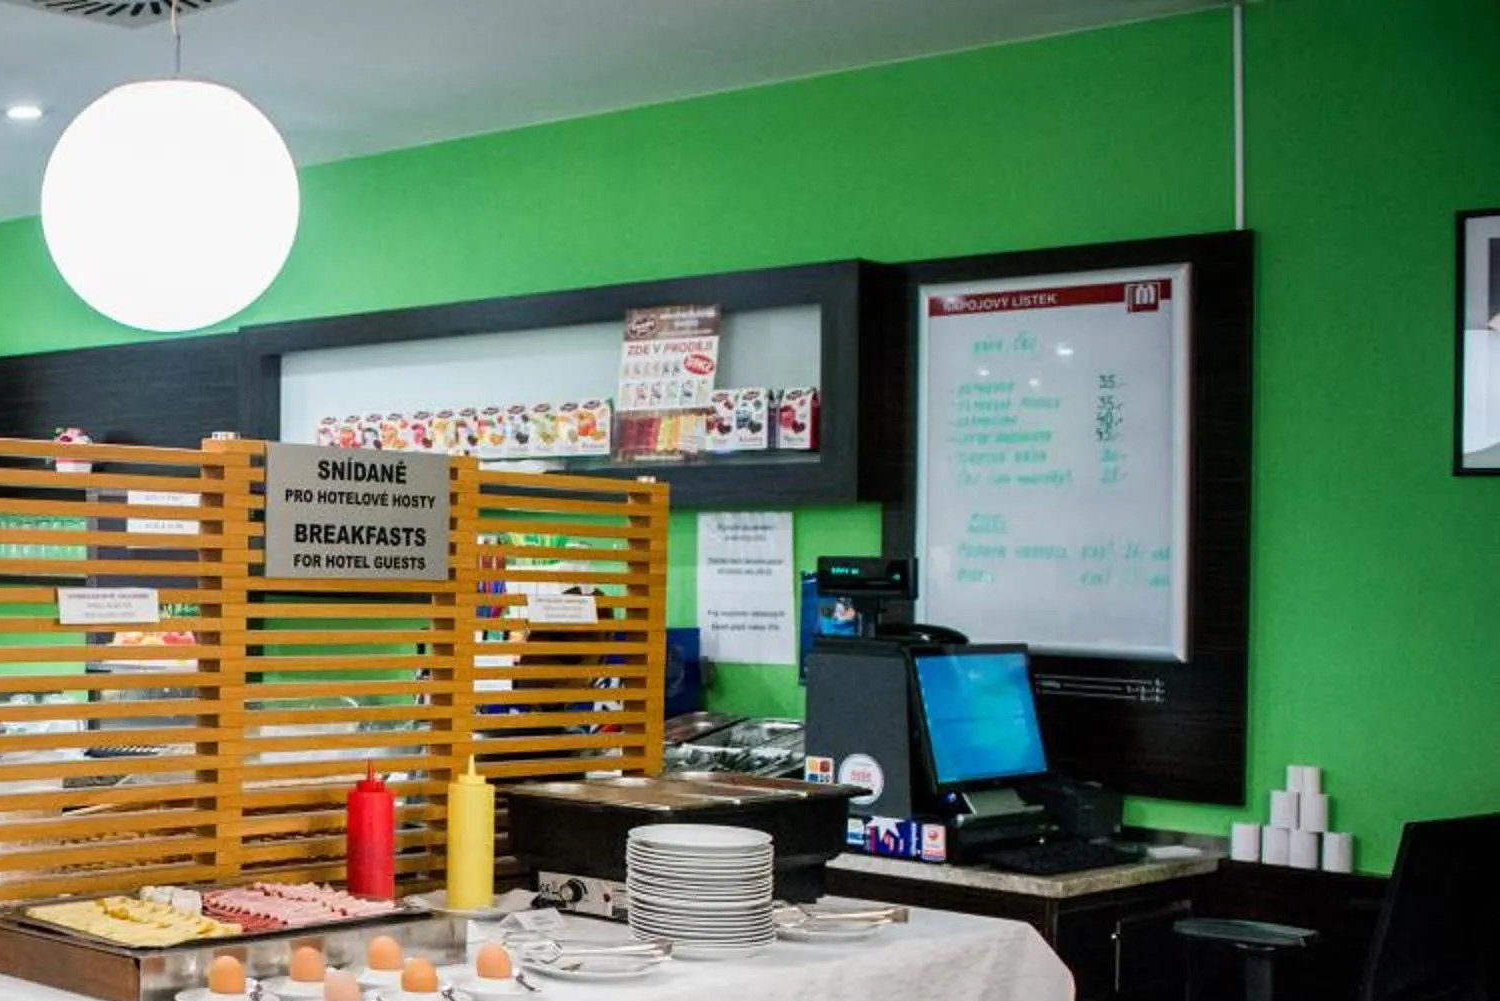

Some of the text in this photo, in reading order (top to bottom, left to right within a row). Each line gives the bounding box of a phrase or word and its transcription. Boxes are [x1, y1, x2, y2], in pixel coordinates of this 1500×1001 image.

[285, 489, 436, 509] PRO HOTELOVÉ HOSTY
[294, 523, 427, 547] BREAKFASTS
[293, 553, 427, 570] FOR HOTEL GUESTS
